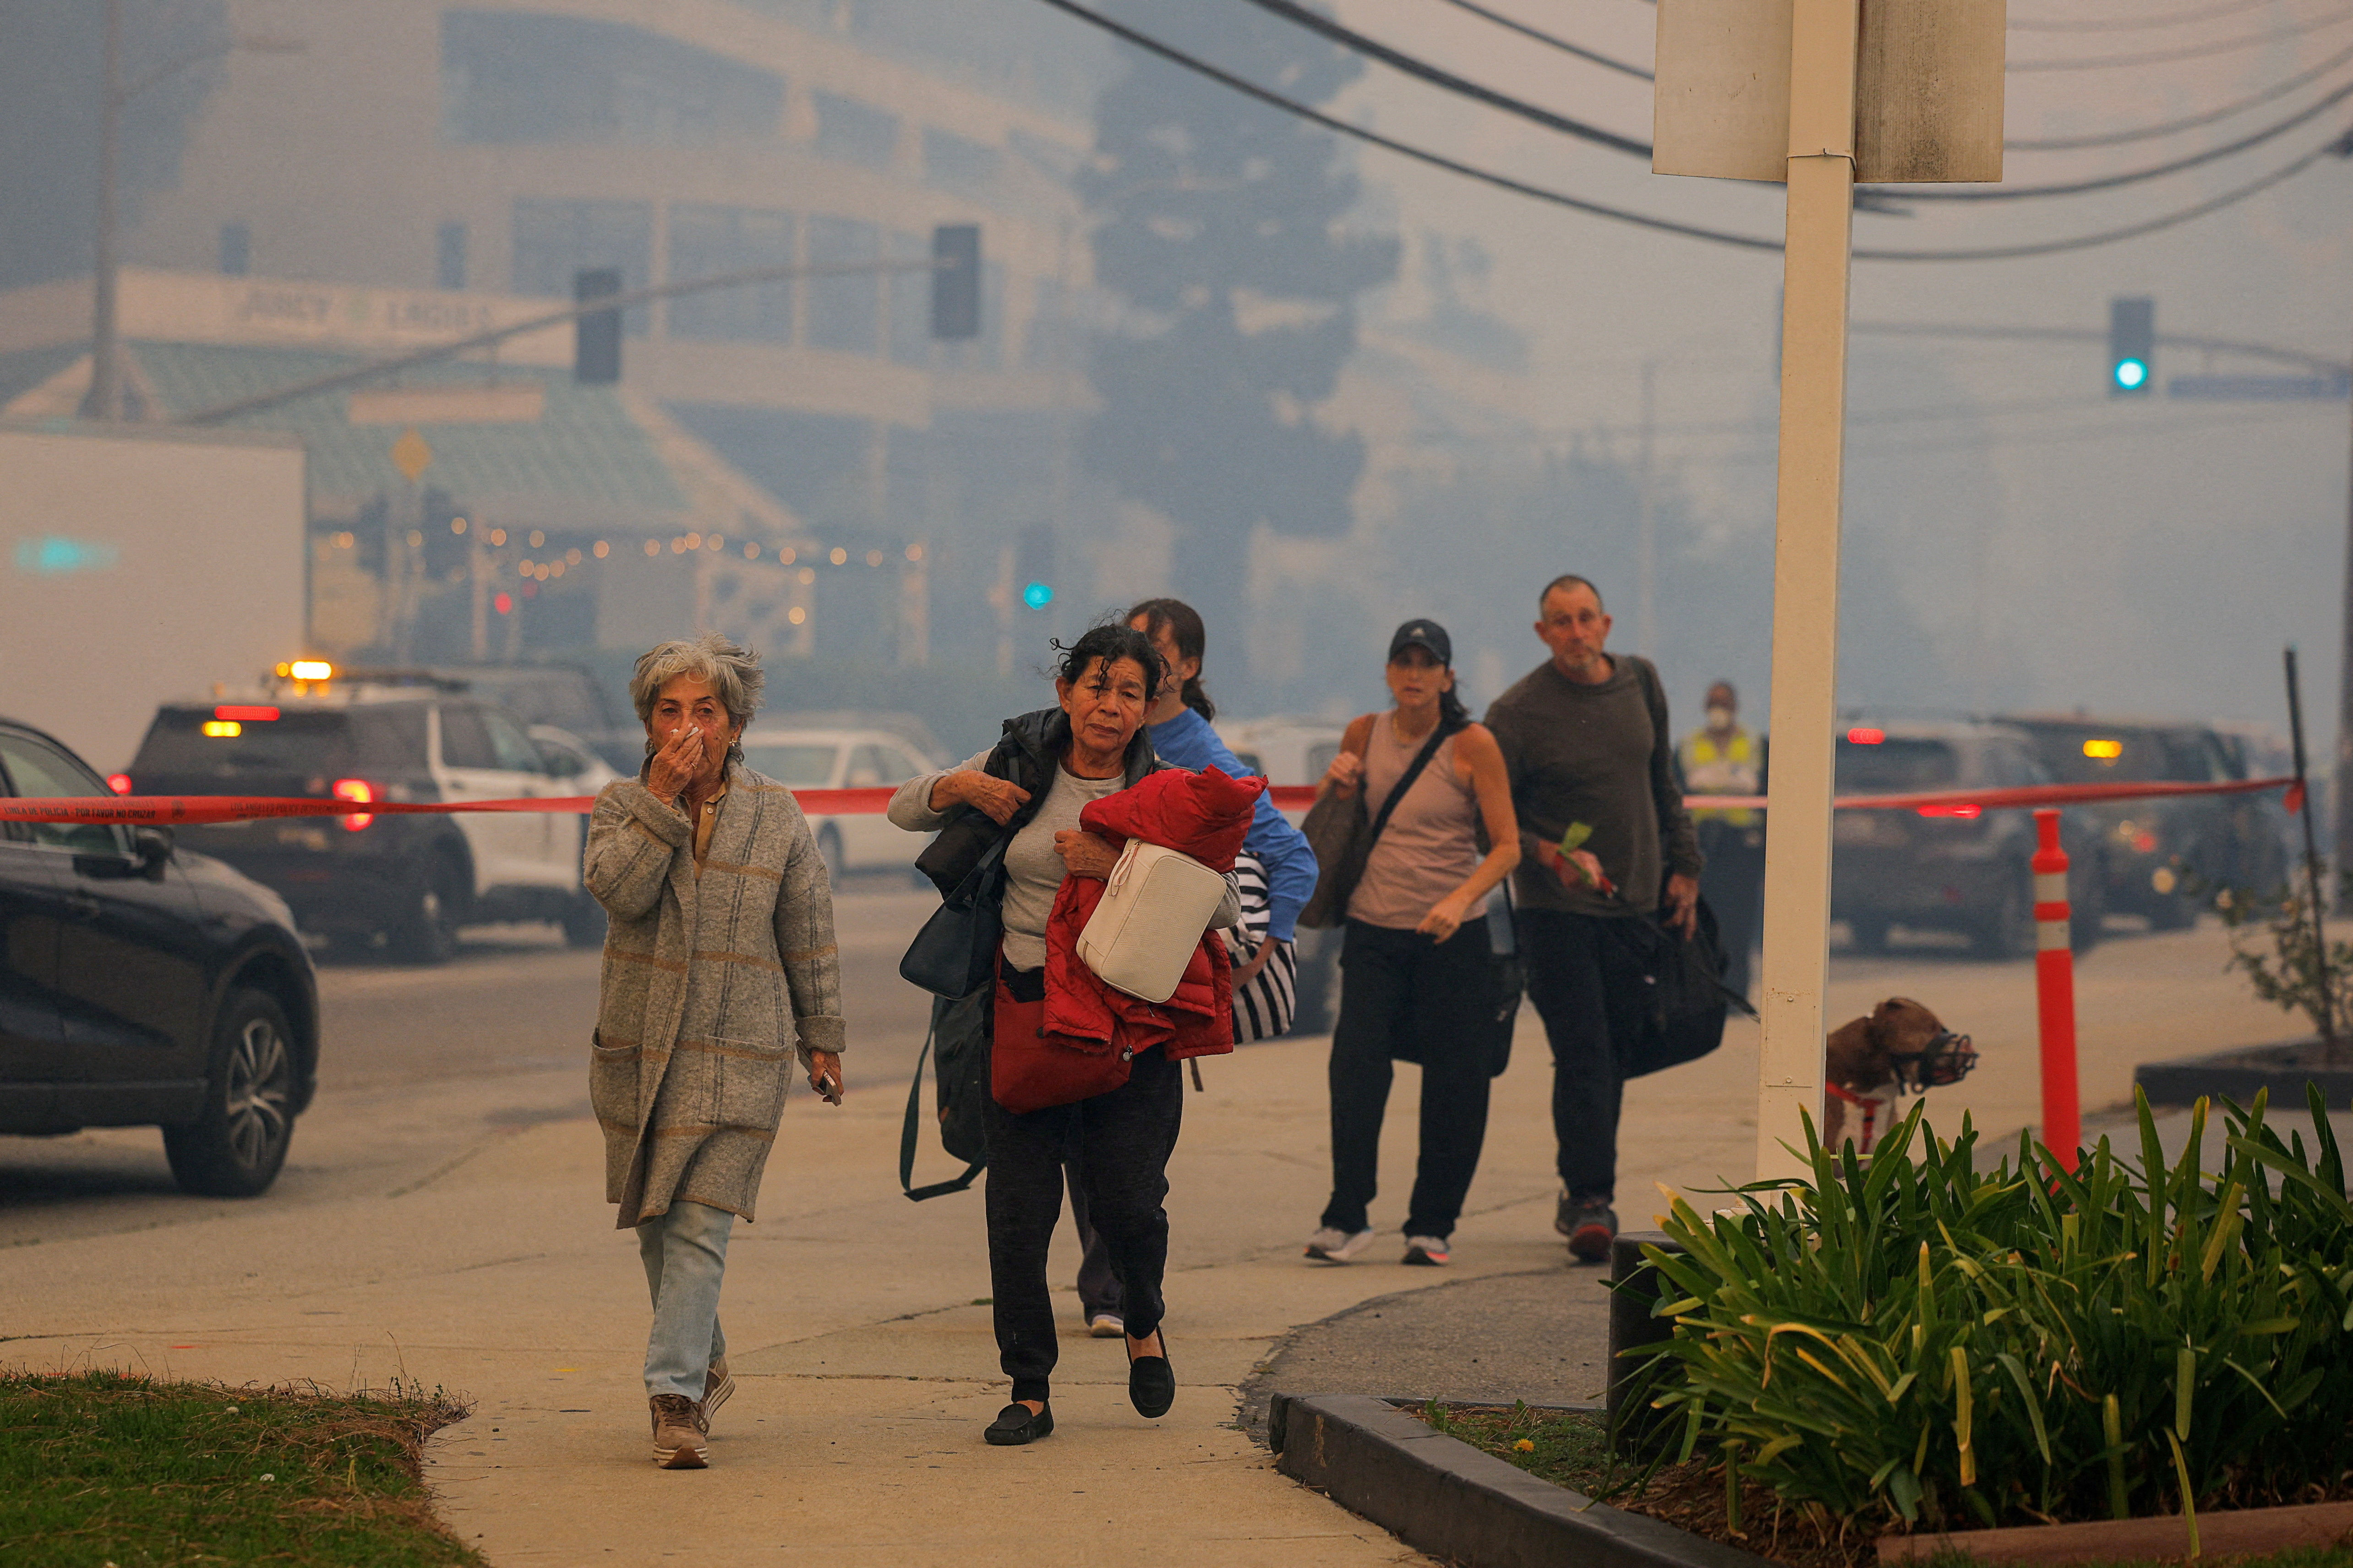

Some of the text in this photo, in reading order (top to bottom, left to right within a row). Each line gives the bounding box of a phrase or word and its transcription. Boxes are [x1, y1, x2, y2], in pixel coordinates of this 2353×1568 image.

[4, 806, 27, 815] LINEA
[28, 807, 38, 815] DE
[40, 807, 68, 816] POLICIA
[76, 808, 90, 817] POR
[92, 808, 114, 817] FAVOR
[116, 809, 126, 818] NO
[128, 809, 155, 819] CRUZAR
[231, 803, 243, 811] LOS
[245, 803, 274, 813] ANGELES
